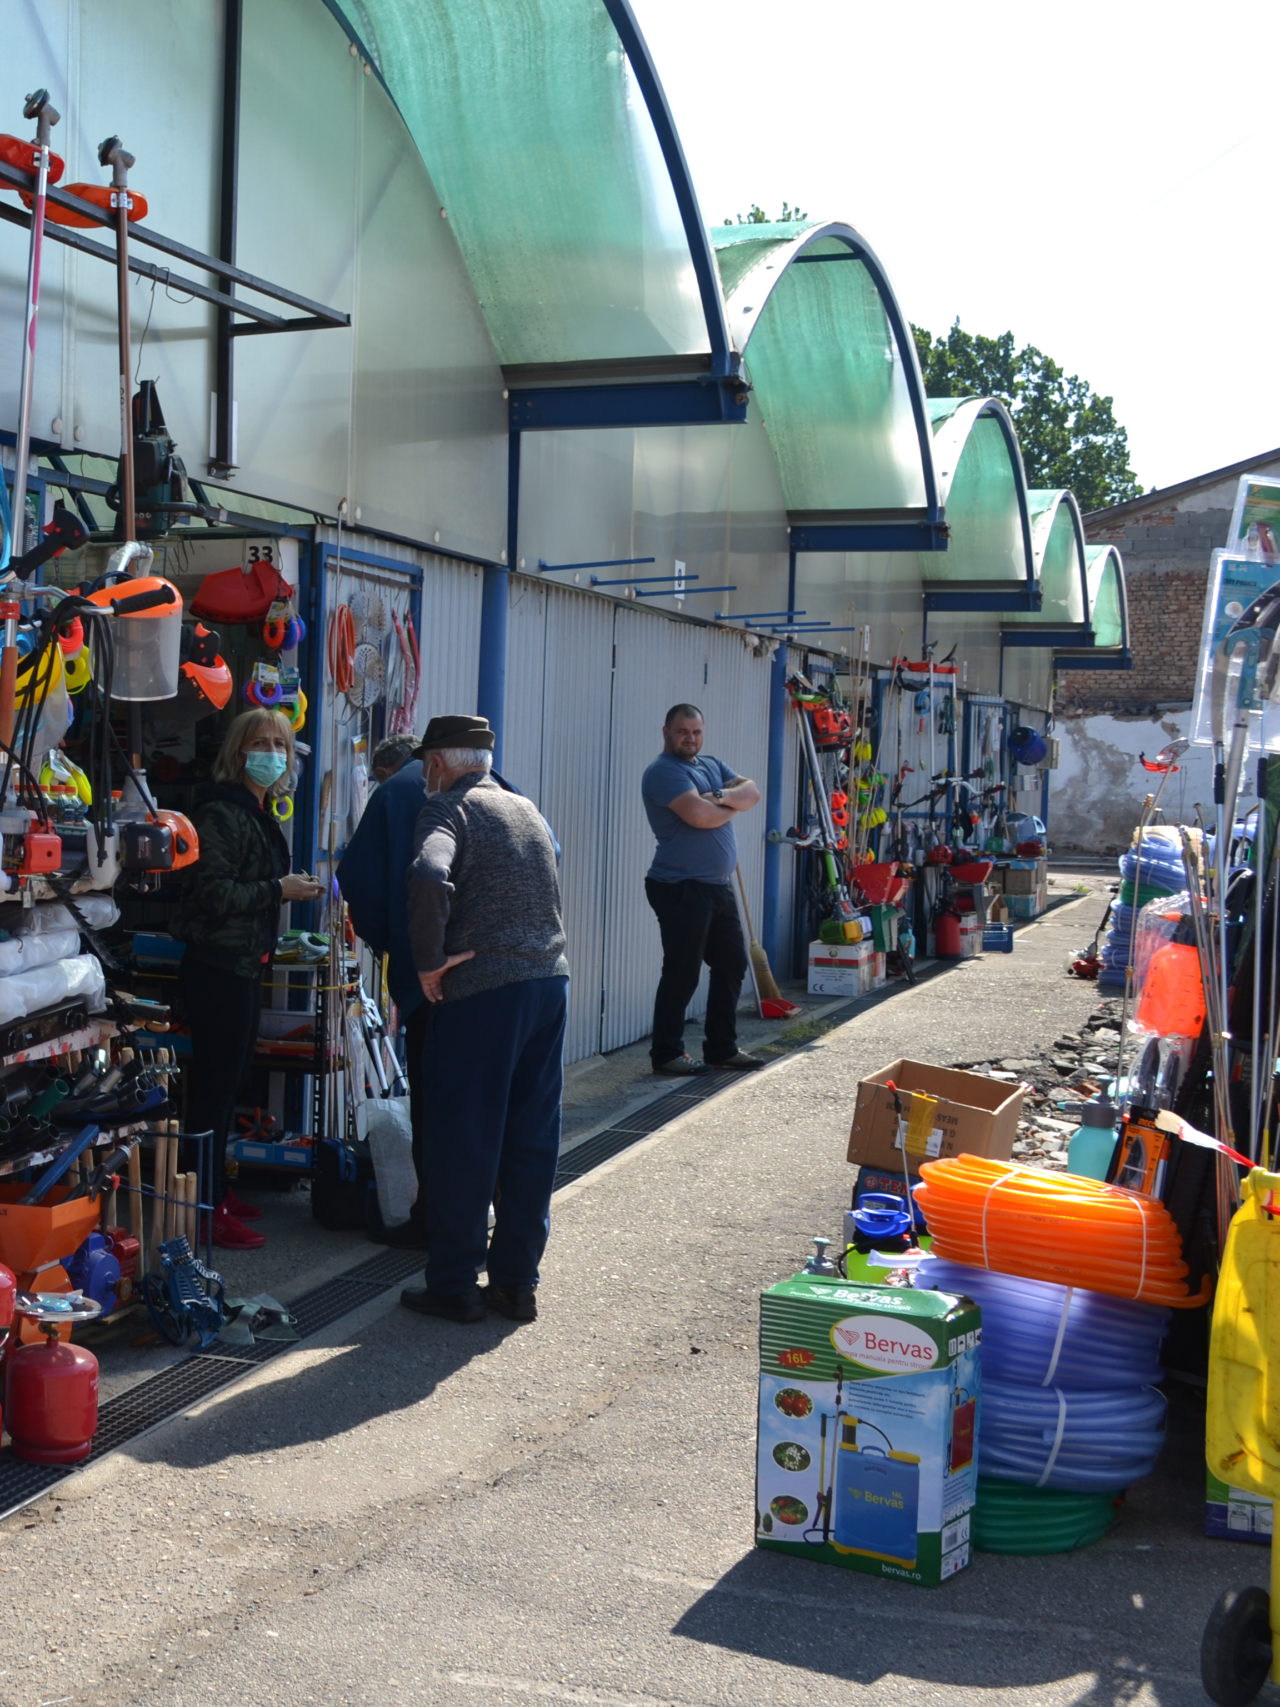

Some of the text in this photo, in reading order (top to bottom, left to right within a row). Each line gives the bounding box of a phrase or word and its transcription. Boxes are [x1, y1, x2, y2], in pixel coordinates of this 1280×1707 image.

[248, 545, 274, 564] 33
[863, 1331, 933, 1361] Bervas
[785, 1352, 808, 1365] 16L
[887, 1357, 910, 1368] pentru
[863, 1490, 905, 1510] Bervas
[881, 1562, 922, 1581] bervas.ro
